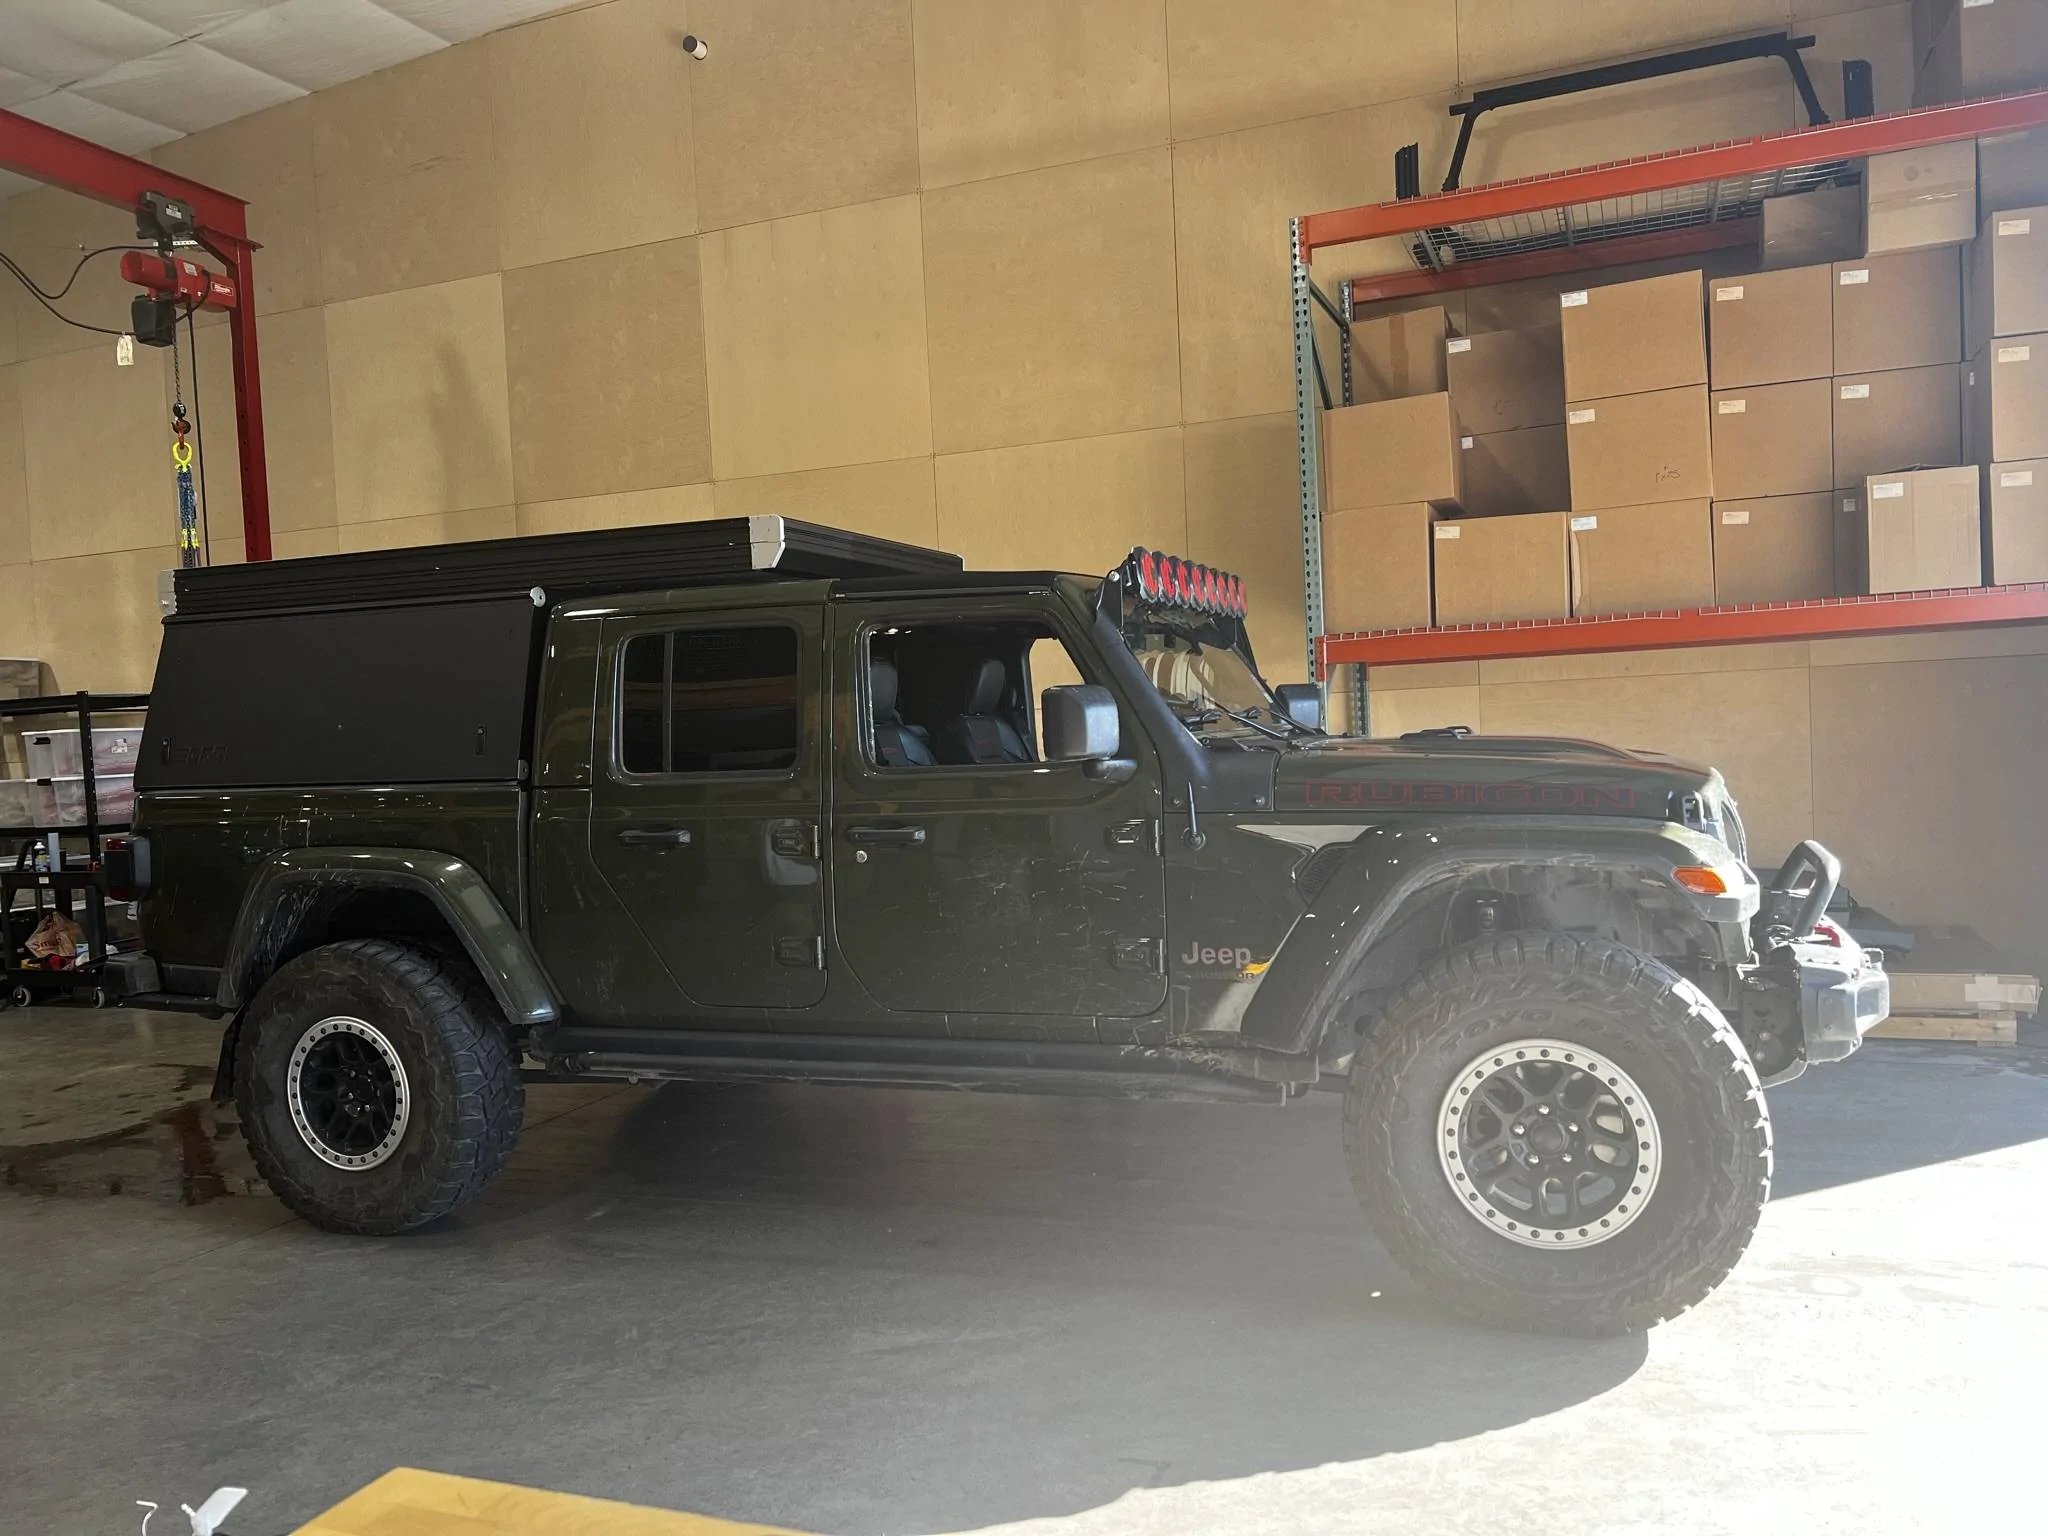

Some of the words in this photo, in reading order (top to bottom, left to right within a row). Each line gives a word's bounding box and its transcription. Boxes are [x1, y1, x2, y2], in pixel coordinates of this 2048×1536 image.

[1304, 778, 1635, 809] RUBICON
[1181, 941, 1252, 969] Jeep
[1439, 1007, 1553, 1052] TOYO
